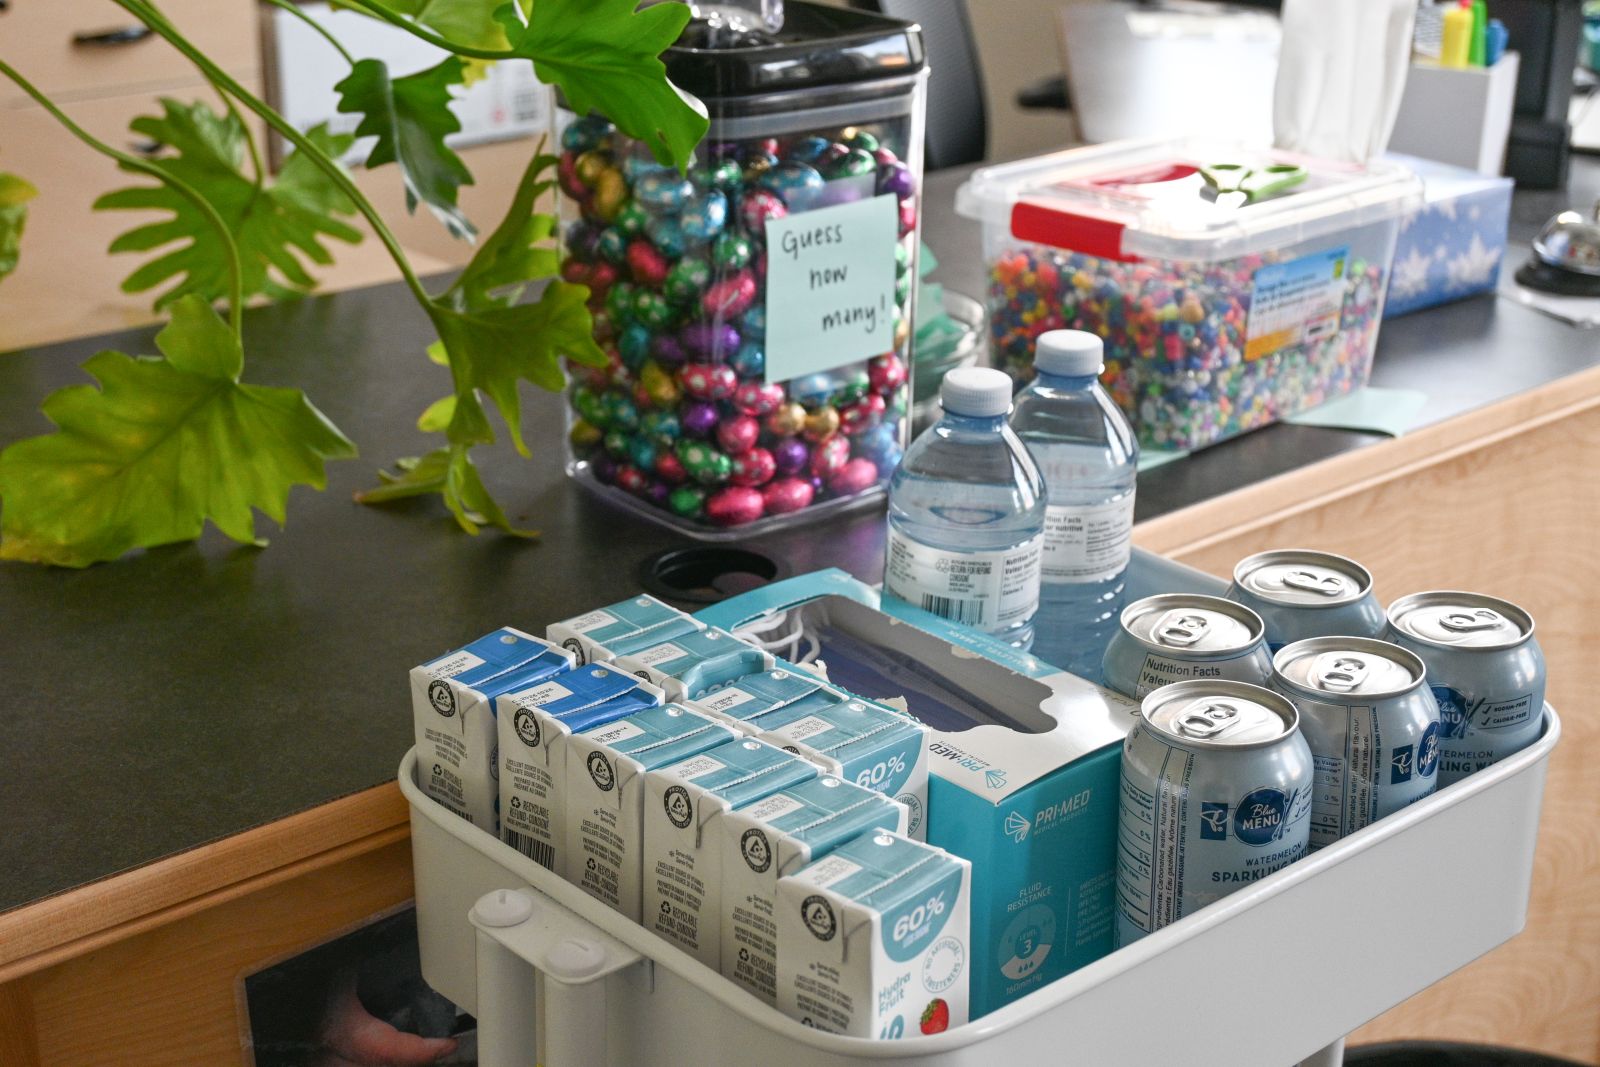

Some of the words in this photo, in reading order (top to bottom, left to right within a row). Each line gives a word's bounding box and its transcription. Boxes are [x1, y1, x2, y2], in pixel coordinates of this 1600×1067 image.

[781, 224, 842, 260] Guess
[1146, 658, 1189, 676] Nutrition
[1193, 666, 1221, 677] Facts
[1440, 712, 1461, 724] NU
[1438, 750, 1494, 759] TERMELON
[523, 800, 549, 816] RECYCLABLE
[1250, 804, 1277, 818] Blue
[1242, 813, 1280, 830] MENU
[1246, 841, 1302, 866] WATERMELON
[1007, 886, 1052, 912] RESISTANCE
[1020, 882, 1042, 898] FLUID
[893, 890, 945, 942] 60%
[1024, 939, 1032, 954] 3
[926, 962, 961, 990] SWEETENERS
[880, 989, 905, 1017] Fruit
